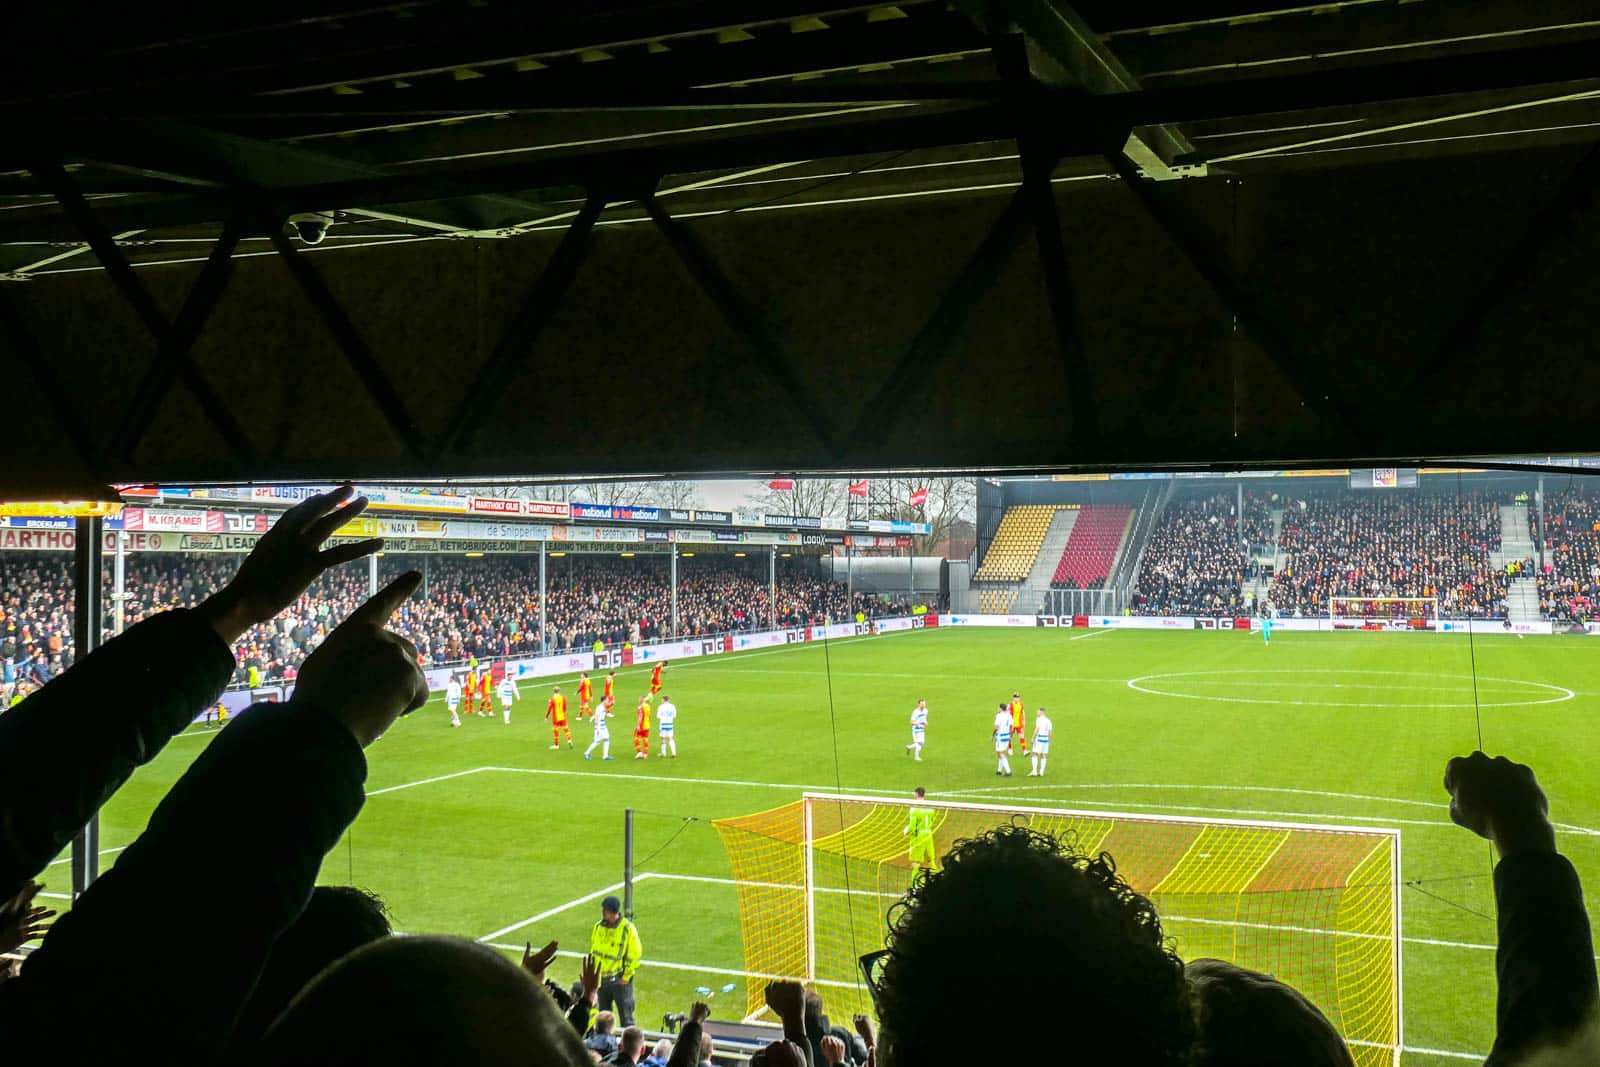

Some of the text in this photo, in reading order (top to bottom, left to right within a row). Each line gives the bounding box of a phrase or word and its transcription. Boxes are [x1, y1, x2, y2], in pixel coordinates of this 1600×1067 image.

[160, 516, 203, 526] KRAMER
[0, 531, 146, 549] ARTHO OIE
[225, 536, 257, 549] LEAD
[384, 540, 407, 551] GING
[439, 541, 517, 551] RETROBRIDGE.COM
